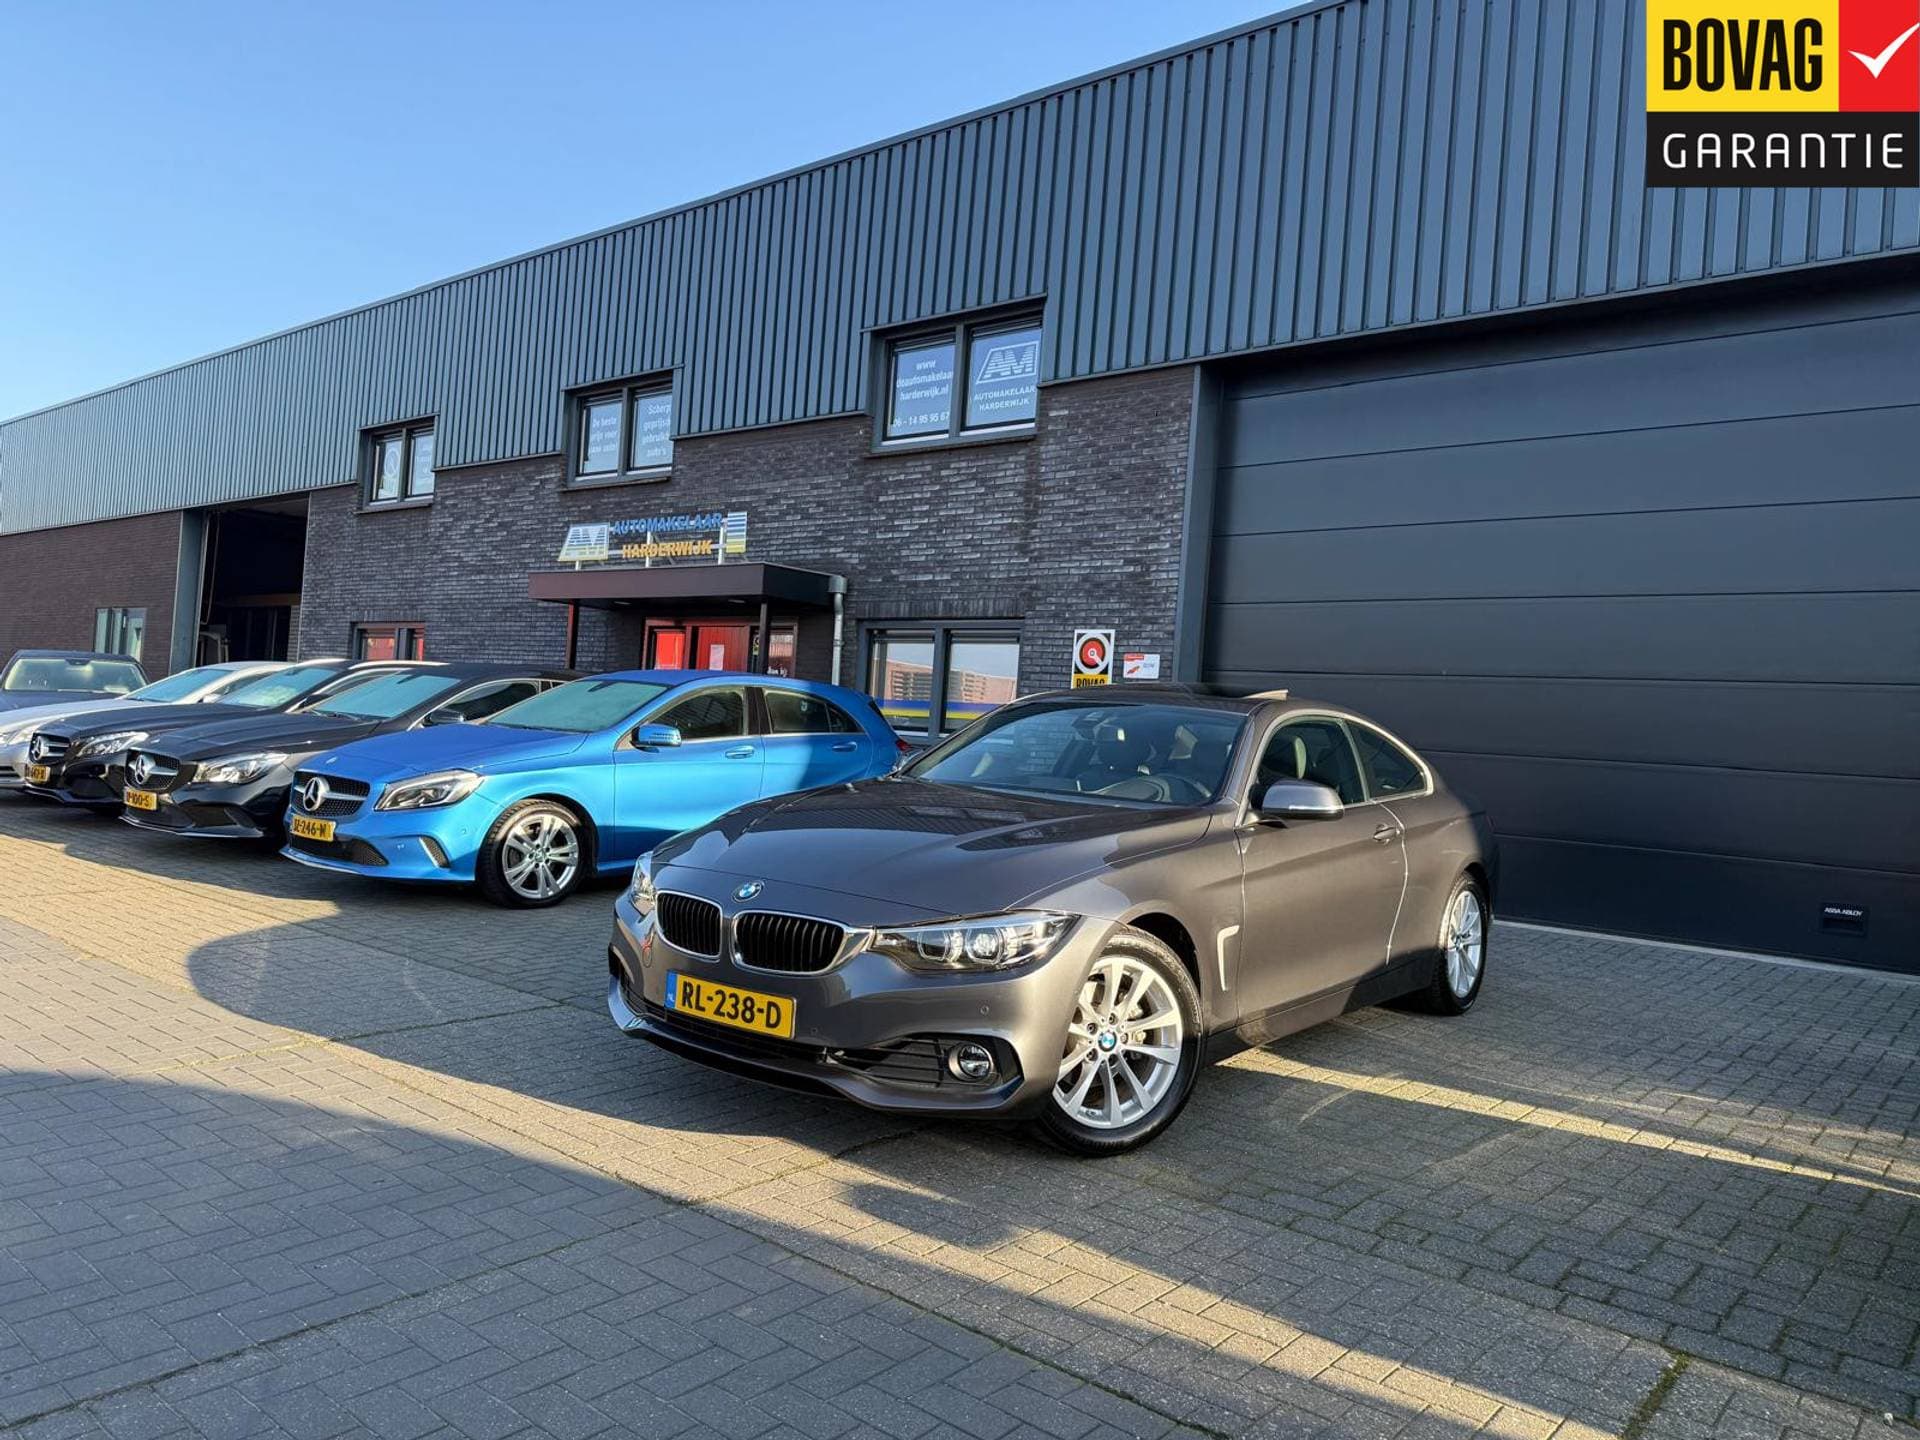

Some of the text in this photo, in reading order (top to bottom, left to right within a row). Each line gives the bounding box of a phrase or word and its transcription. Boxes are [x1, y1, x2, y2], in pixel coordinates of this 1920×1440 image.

[974, 386, 1035, 401] AUTOMAKELAAR
[979, 398, 1030, 411] HARDERWIJK
[612, 512, 723, 535] AUTOMAKELAAR
[622, 540, 713, 558] HARDERWIJK
[682, 980, 782, 1029] RL-238-D
